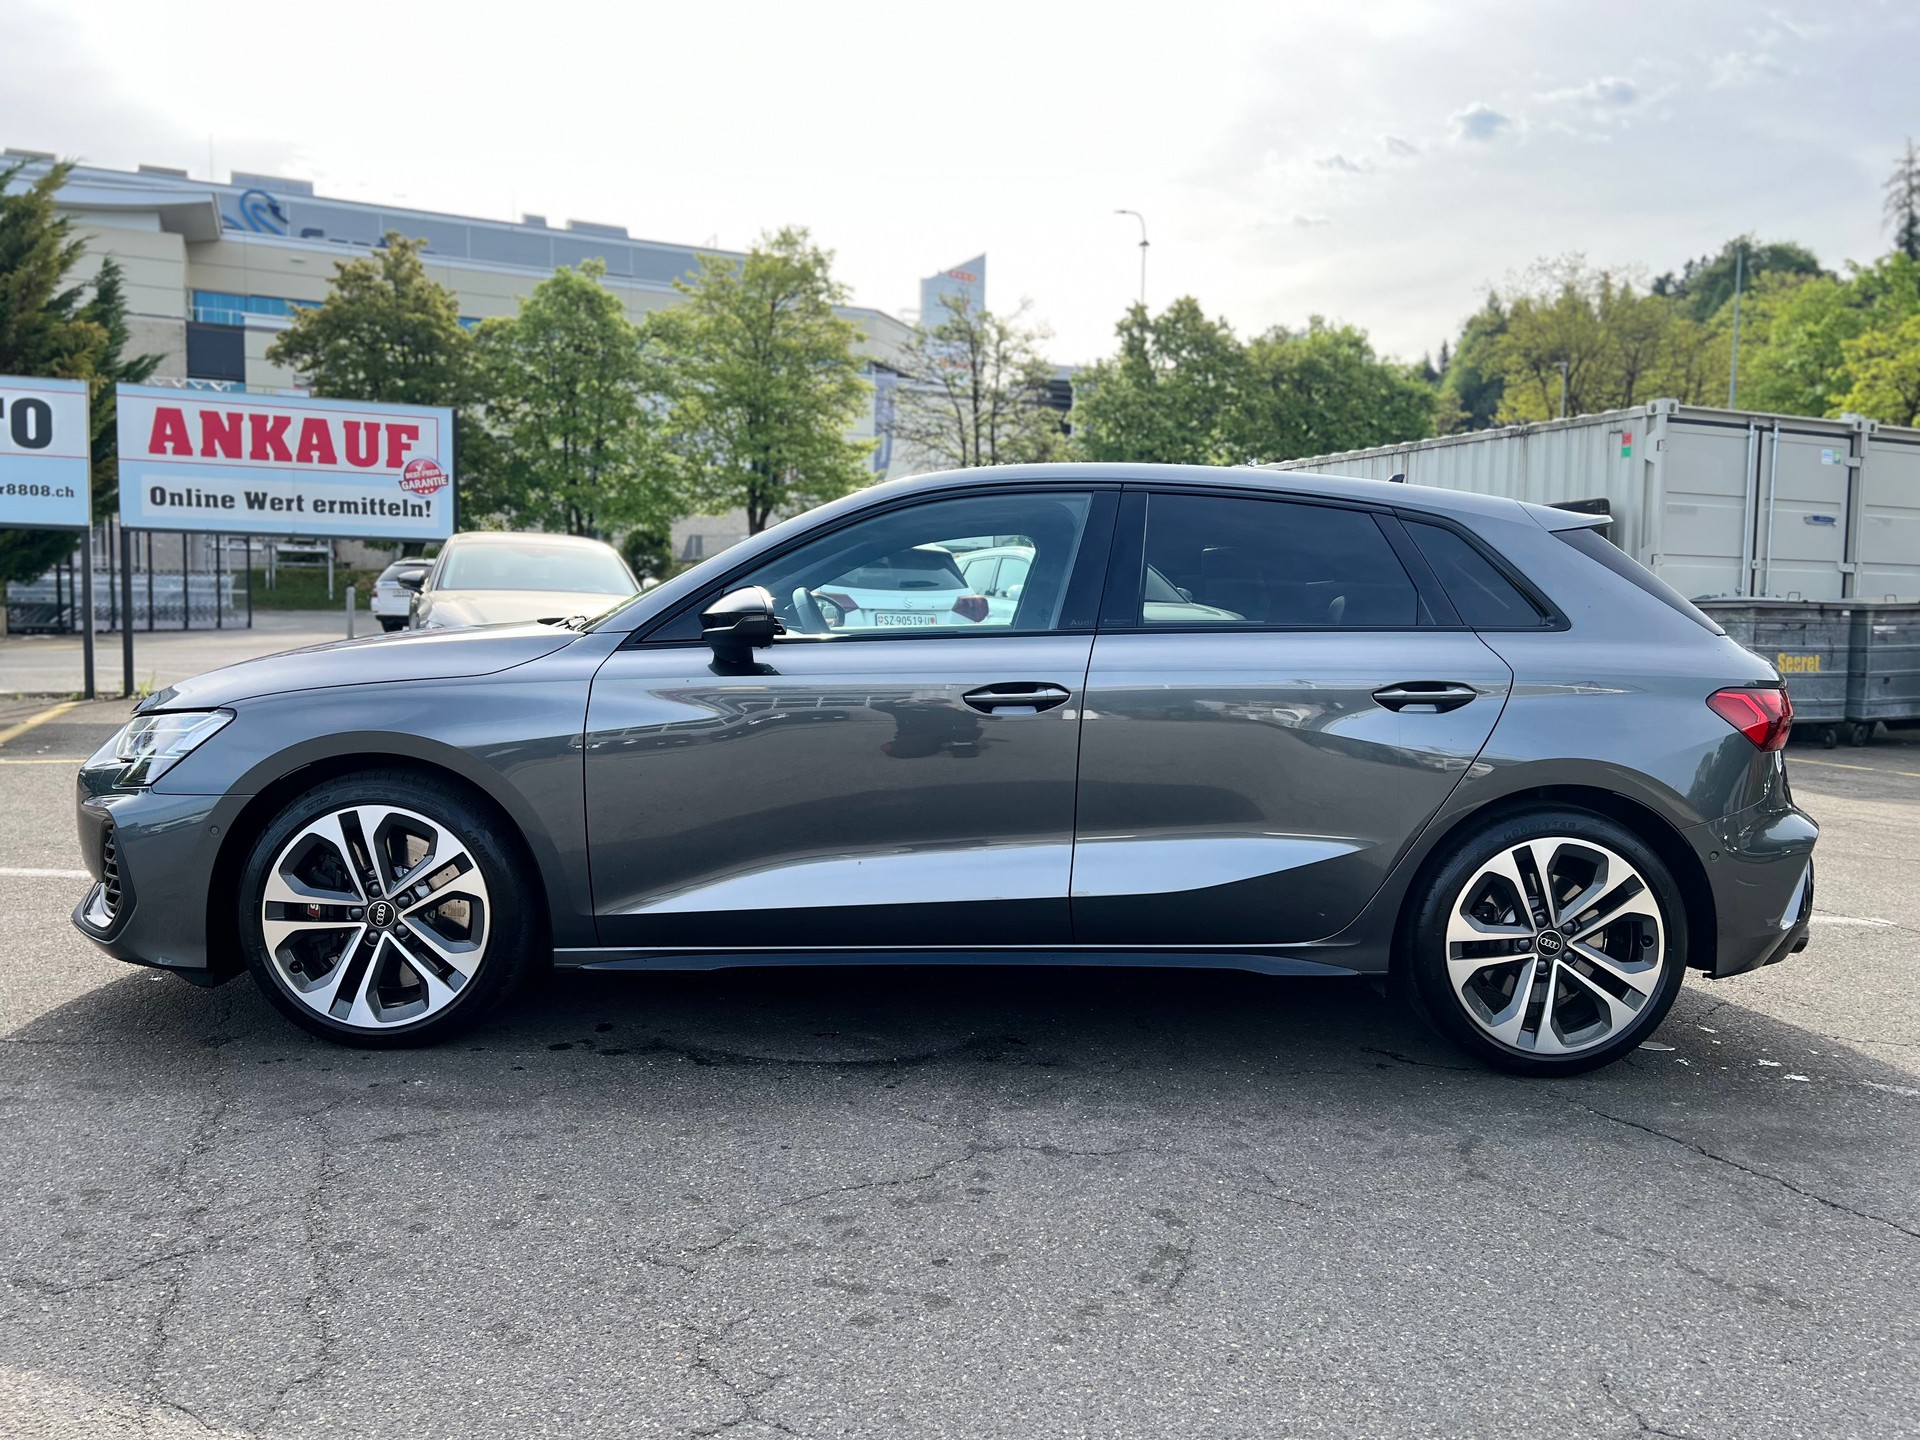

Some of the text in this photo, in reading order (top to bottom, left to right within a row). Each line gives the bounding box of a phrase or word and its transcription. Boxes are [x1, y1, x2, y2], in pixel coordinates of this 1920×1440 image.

[0, 397, 52, 449] O
[148, 407, 419, 468] ANKAUF
[401, 476, 447, 490] GARANTIE
[150, 486, 431, 518] Online Wert ermitteln!
[1777, 652, 1821, 673] Secret
